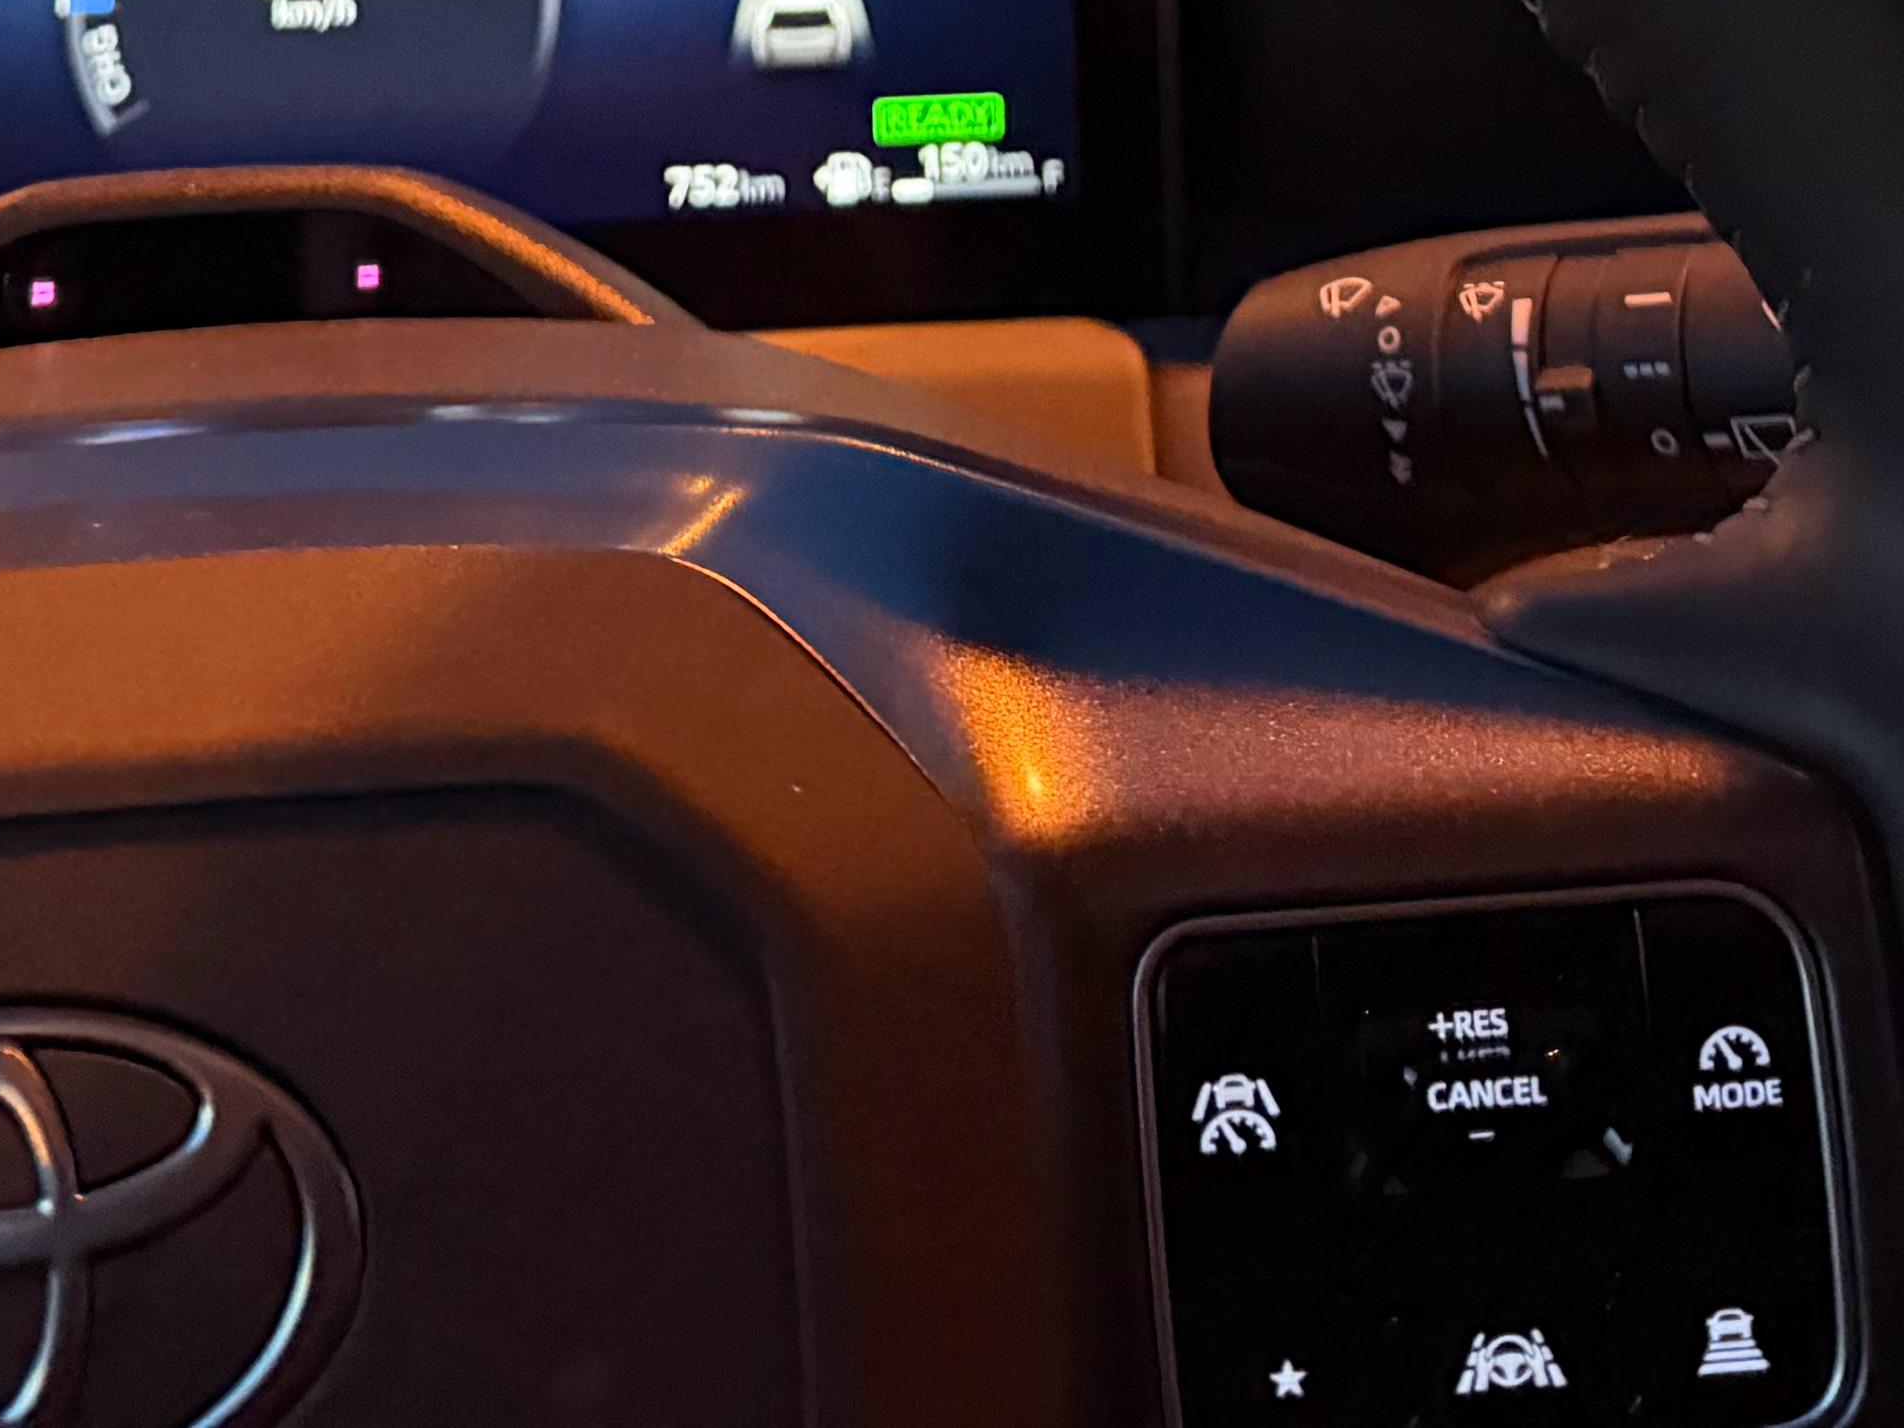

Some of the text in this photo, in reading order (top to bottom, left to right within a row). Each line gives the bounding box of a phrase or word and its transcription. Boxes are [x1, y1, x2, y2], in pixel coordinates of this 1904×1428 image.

[885, 102, 993, 138] READY
[1426, 1074, 1549, 1114] CANCEL
[1693, 1077, 1785, 1114] MODE
